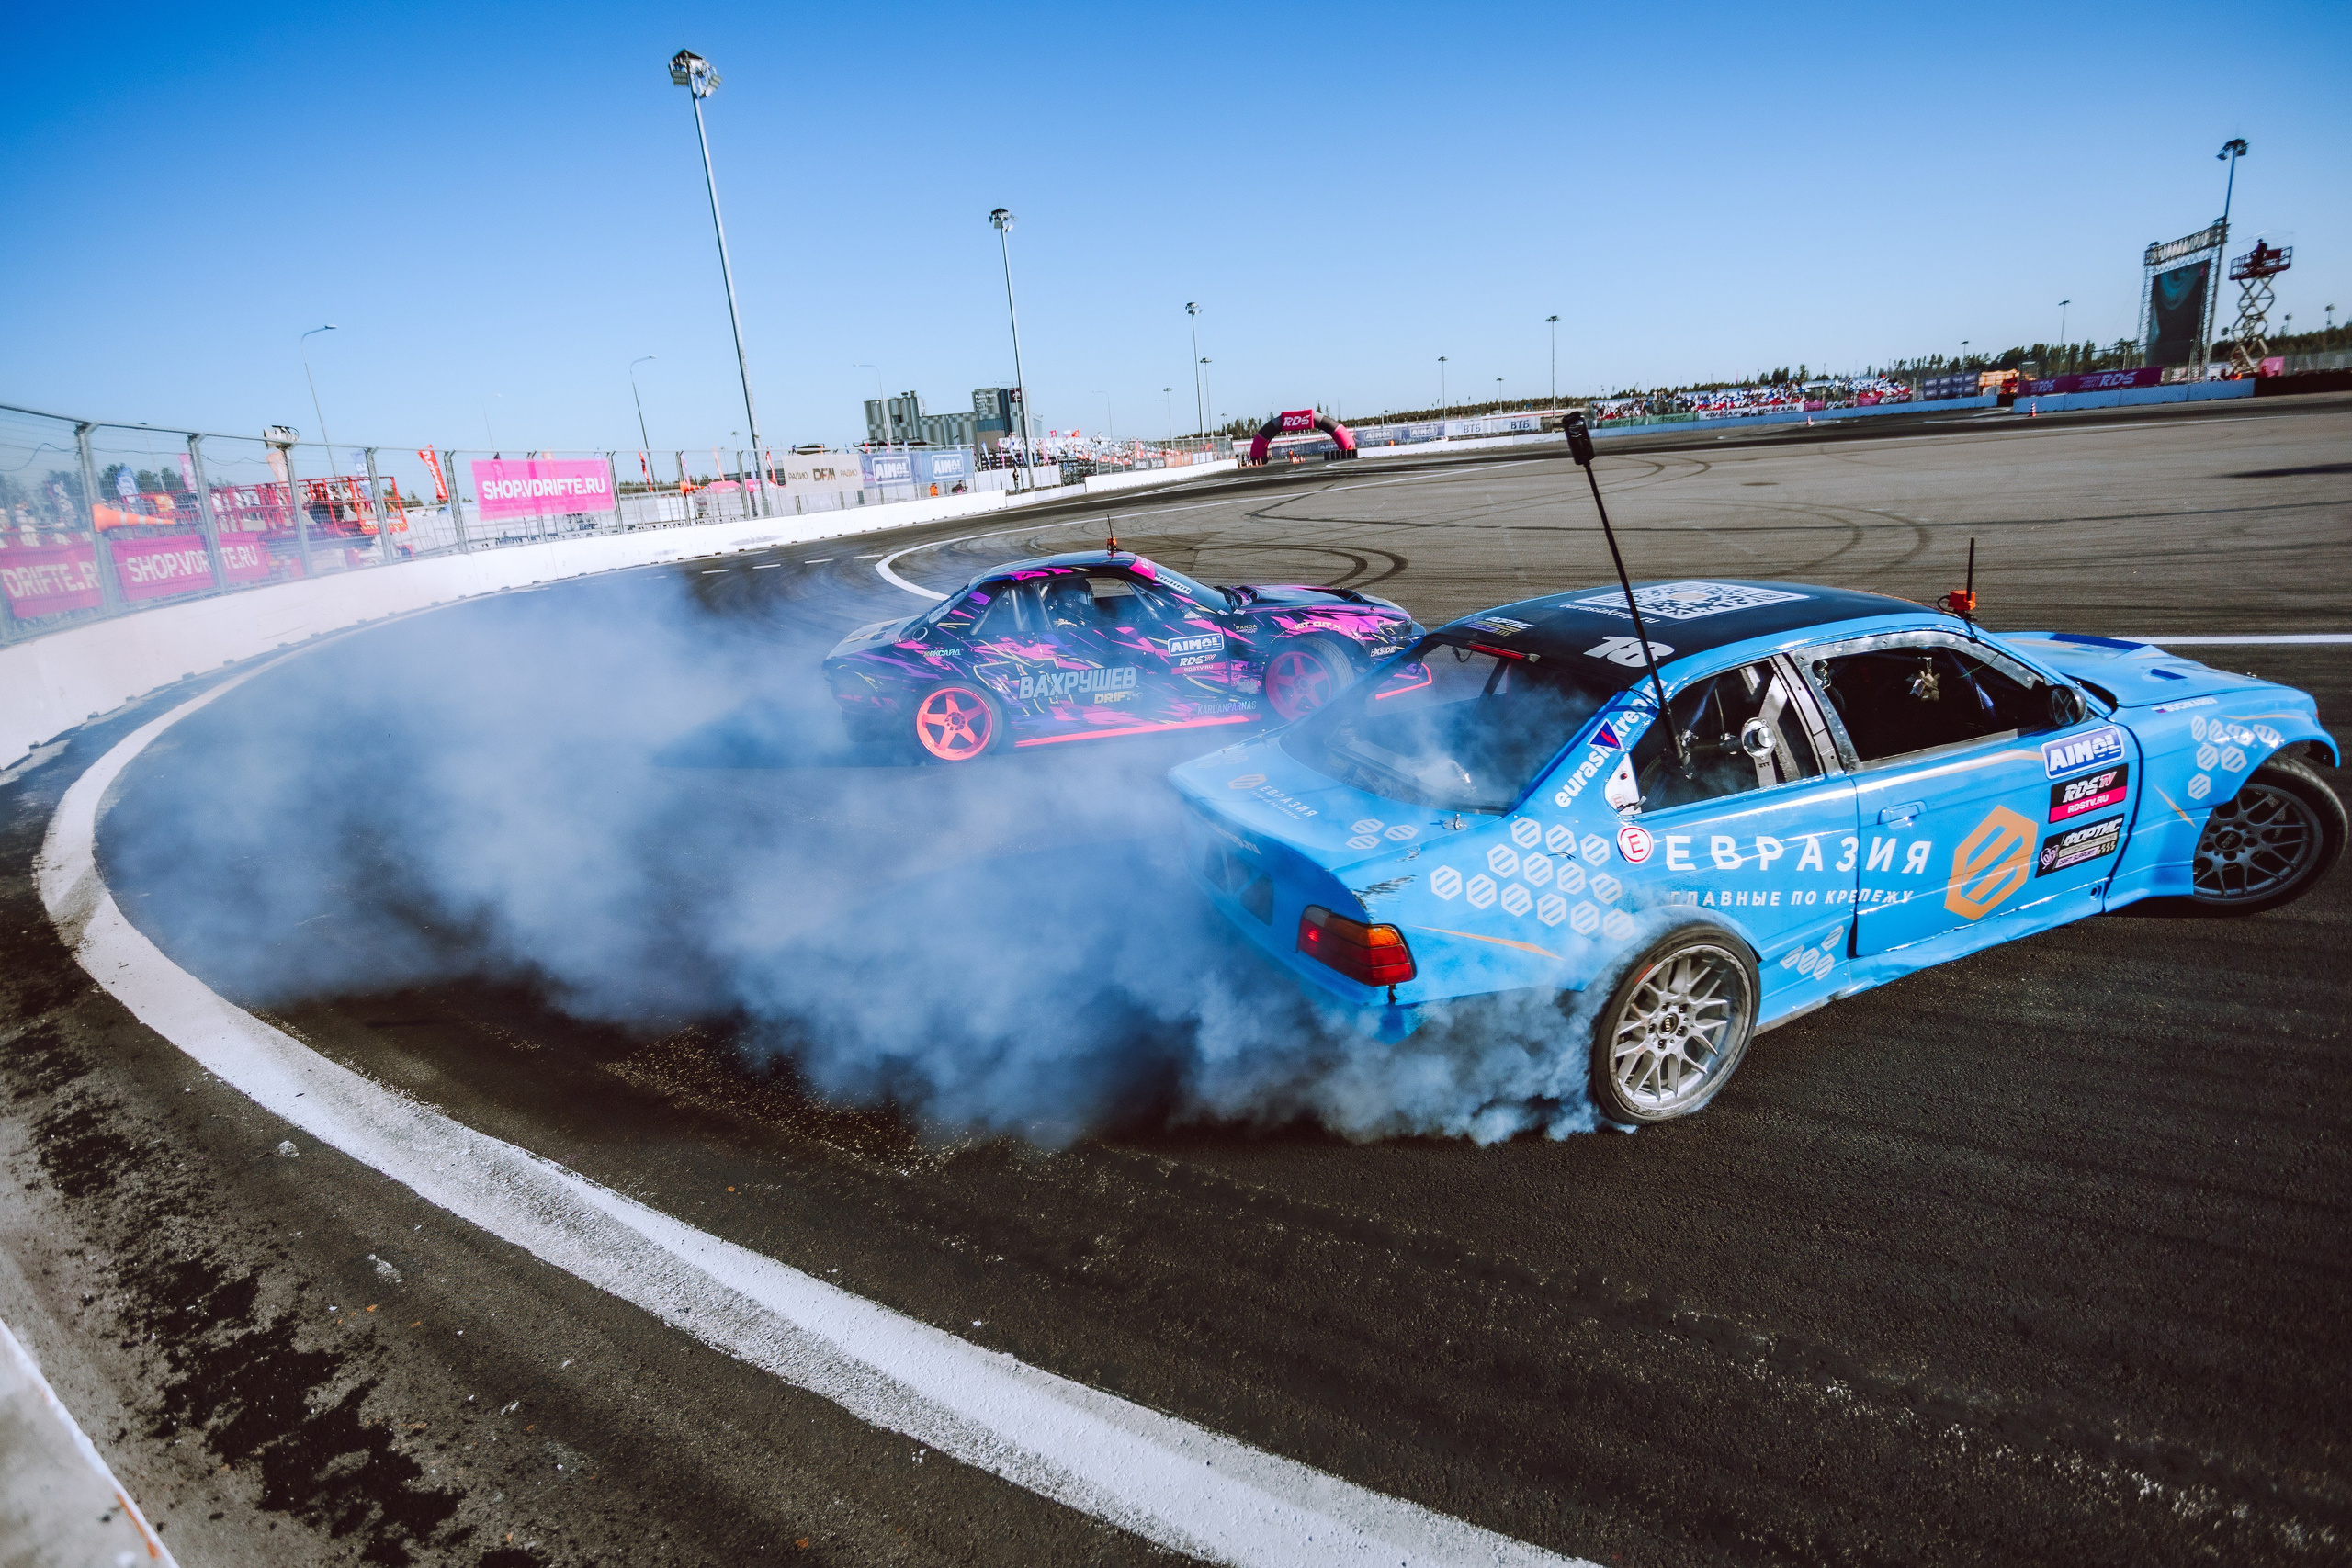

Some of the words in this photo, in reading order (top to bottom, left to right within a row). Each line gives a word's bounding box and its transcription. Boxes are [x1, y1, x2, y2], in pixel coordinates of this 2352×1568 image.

[2099, 371, 2139, 387] RDS
[1283, 414, 1310, 426] RDS
[1464, 423, 1481, 434] ВТБ
[1511, 420, 1530, 429] ВТБ
[1365, 432, 1392, 440] AIMOL
[1411, 427, 1437, 436] AIMOL
[876, 461, 909, 478] AIMOL
[933, 457, 962, 474] AIMOL
[788, 471, 808, 480] РАДИО
[812, 468, 837, 481] DFM
[840, 468, 858, 478] РАДИО
[482, 477, 606, 500] SHOP.VDRIFTE.RU
[1, 560, 101, 598] DRIFTE.R
[1294, 621, 1309, 630] KIT
[1171, 637, 1221, 652] AIMOL
[1180, 655, 1204, 666] RDS
[1019, 667, 1136, 699] ВАХРУШЕВ
[1198, 701, 1257, 715] KARDANPARNAS
[2049, 734, 2120, 772] AIMOL
[2063, 775, 2101, 803] RDS
[1260, 785, 1318, 818] ЕВРАЗИЯ
[2067, 794, 2109, 814] RDSTV.RU
[2063, 818, 2123, 847] ФОРТИС
[1665, 835, 1932, 874] ЕВРАЗИЯ
[1791, 891, 1817, 905] ПО
[1824, 888, 1915, 905] КРЕПЕЖУ
